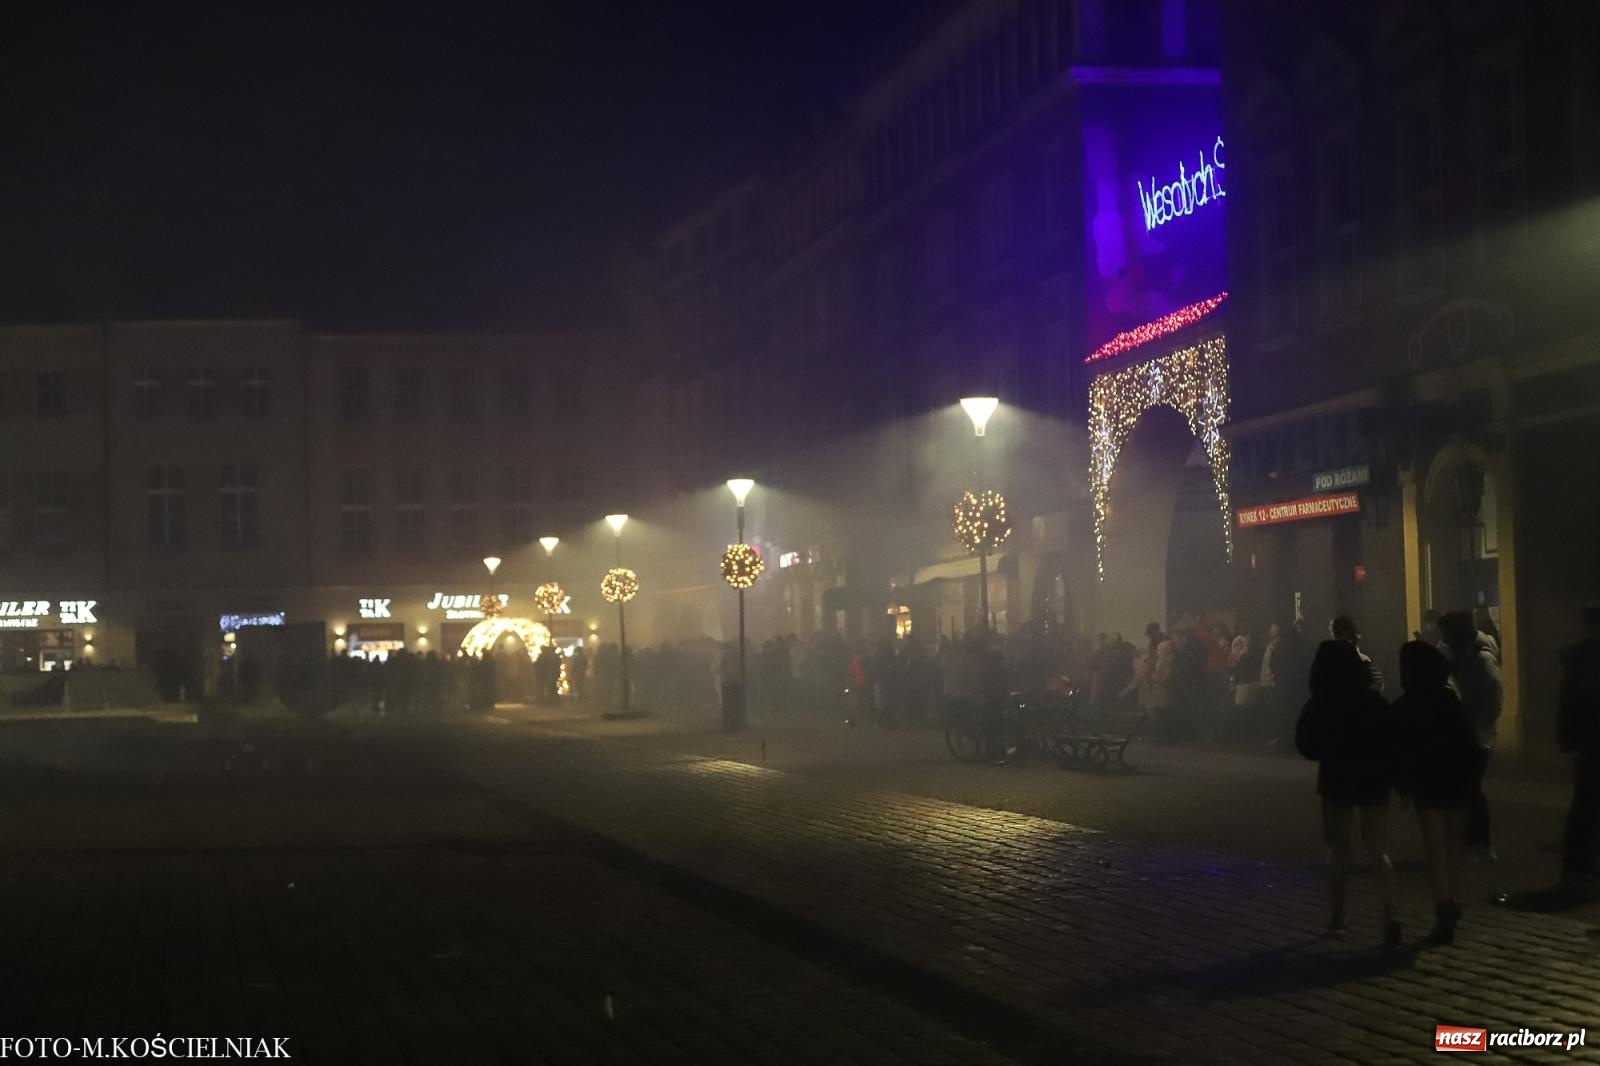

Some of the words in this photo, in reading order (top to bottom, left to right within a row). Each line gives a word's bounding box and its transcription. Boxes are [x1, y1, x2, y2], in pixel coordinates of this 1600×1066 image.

[1315, 474, 1333, 489] POD
[1270, 504, 1297, 520] CENTRUM
[1298, 495, 1357, 516] FARMACEUTYCZNE
